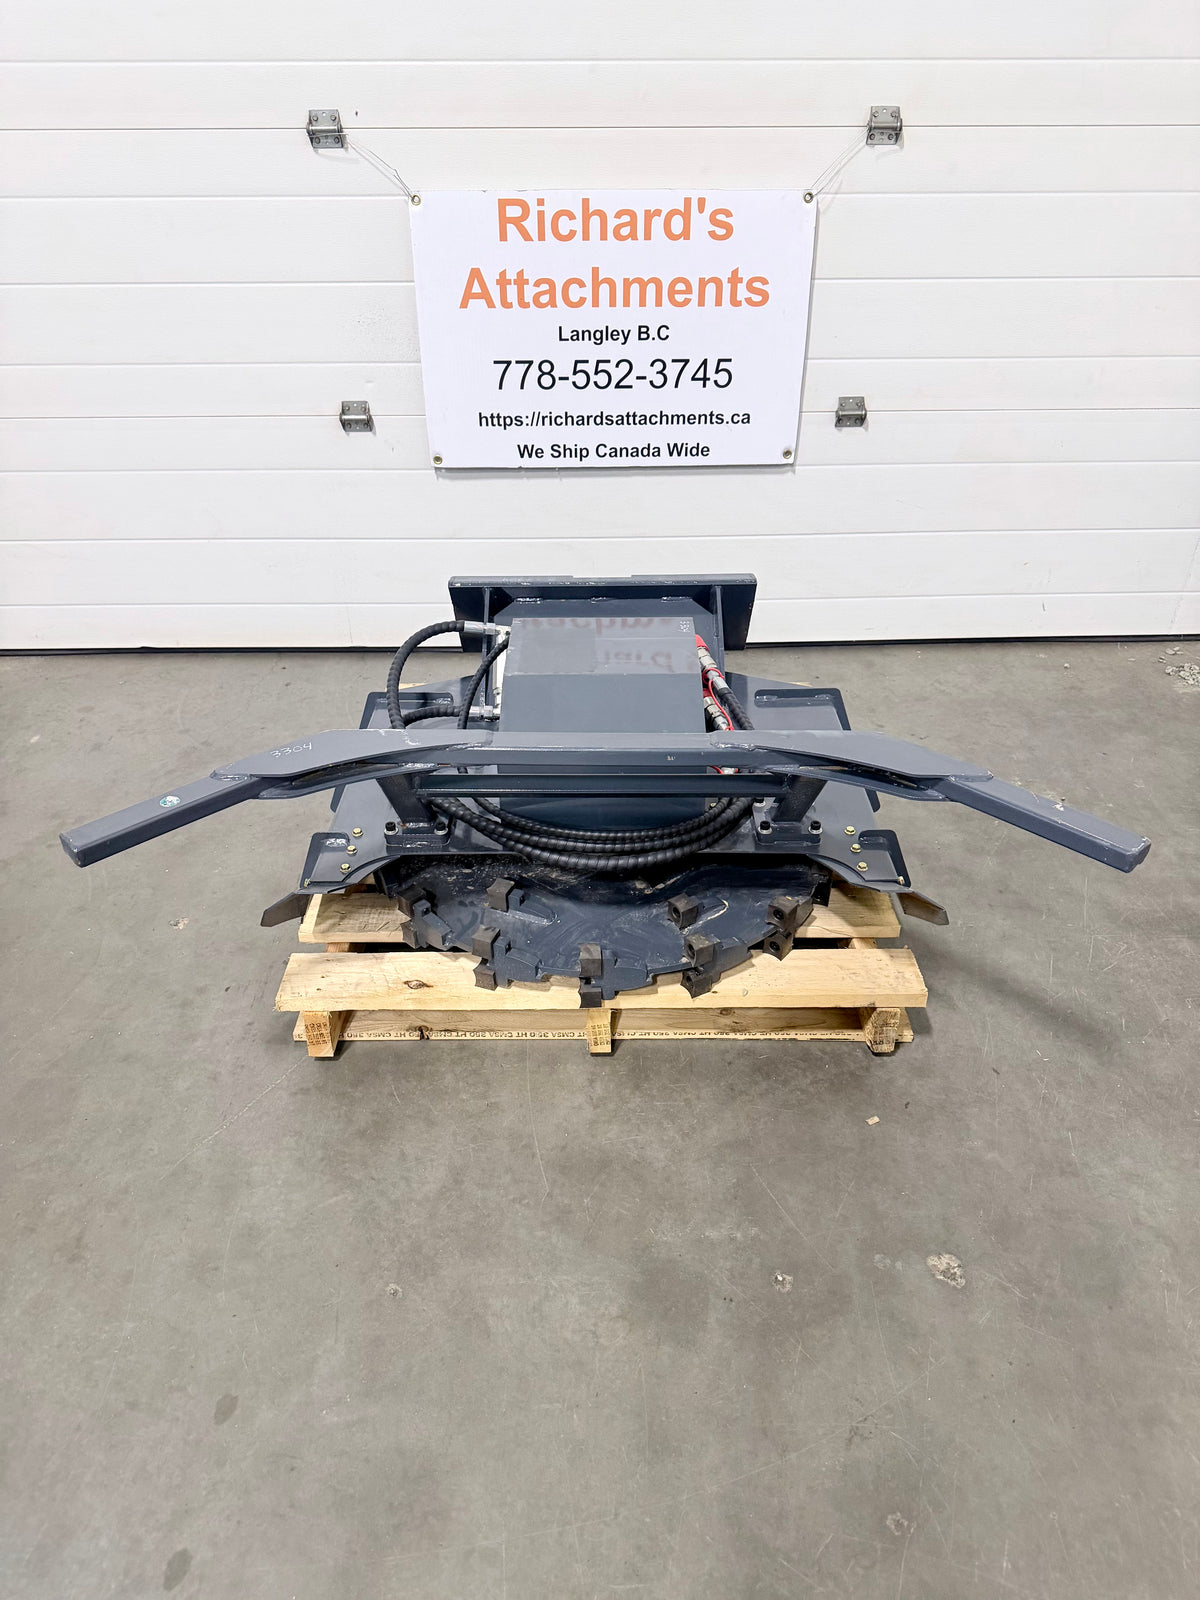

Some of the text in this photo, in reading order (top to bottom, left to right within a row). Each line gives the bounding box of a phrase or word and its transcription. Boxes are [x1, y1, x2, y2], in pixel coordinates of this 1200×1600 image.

[498, 197, 734, 242] Richard's
[459, 267, 770, 309] Attachments
[558, 325, 670, 345] Langley B.C
[493, 358, 733, 390] 778-552-3745
[478, 411, 751, 430] https://richardsattachments.ca
[517, 443, 711, 461] We Ship Canada Wide
[270, 742, 312, 758] 3304
